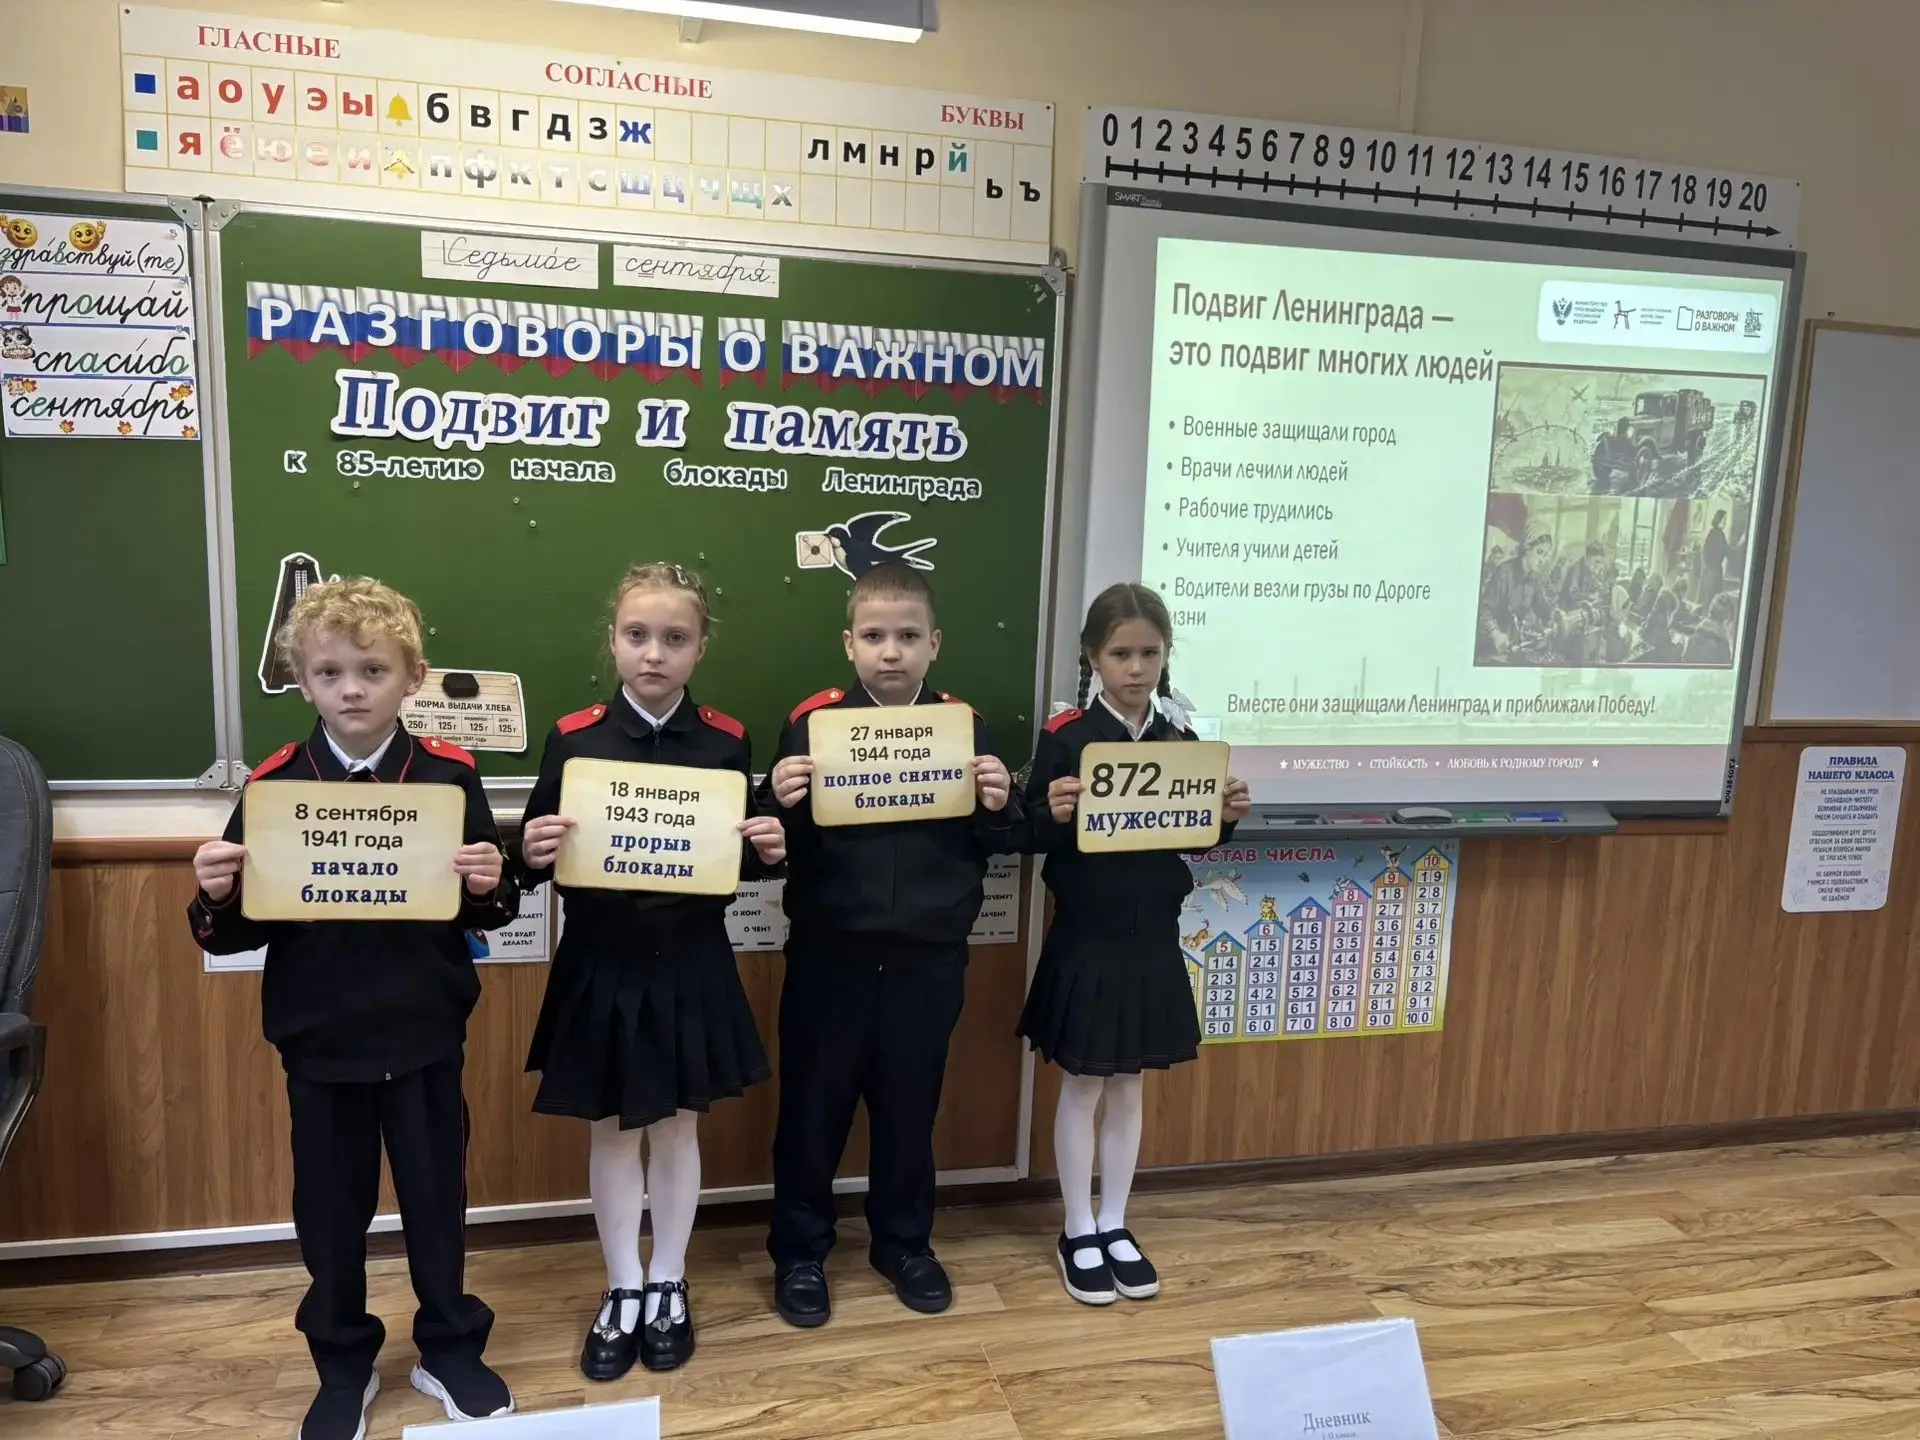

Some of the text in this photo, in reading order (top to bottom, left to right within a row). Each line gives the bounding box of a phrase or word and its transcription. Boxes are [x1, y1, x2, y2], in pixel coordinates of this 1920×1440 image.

[197, 25, 340, 60] ГЛАСНЫЕ
[545, 62, 712, 99] СОГЛАСНЫЕ
[940, 104, 1025, 130] БУКВЫ
[1103, 113, 1767, 213] 0 1 2 3 4 5 6 7 8 9 10 11 12 13 14 15 16 17 18 19 20
[1114, 191, 1142, 202] SMART
[1172, 283, 1424, 333] Подвиг Ленинграда
[1696, 309, 1739, 322] РАЗГОВОРЫ
[1695, 322, 1735, 333] О ВАЖНОМ
[261, 298, 1043, 388] РАЗГОВОРЫ О ВАЖНОМ
[1169, 340, 1493, 384] это подвиг многих людей
[338, 376, 963, 456] Подвиг и память
[1183, 415, 1396, 446] Военные защищали город
[286, 452, 980, 499] к 85-летию начала блокады Ленинграда
[1181, 457, 1348, 483] Врачи лечили людей
[1178, 497, 1333, 523] Рабочие трудились
[1175, 537, 1338, 562] Учителя учили детей
[1174, 577, 1431, 603] Водители везли грузы по Дороге
[415, 700, 512, 712] НОРМА ВЫДАЧИ ХЛЕБА
[1227, 694, 1656, 717] Вместе они защищали Ленинград и приближали Победу!
[408, 721, 423, 729] 250
[438, 722, 452, 730] 125
[470, 723, 483, 731] 125
[499, 725, 512, 733] 125
[851, 726, 933, 742] 27 января
[850, 746, 931, 762] 1944 года
[1292, 758, 1583, 770] МУЖЕСТВО СТОЙКОСТЬ ЛЮБОВЬ К РОДНОМУ ГОРОДУ
[1829, 757, 1878, 766] ПРАВИЛА
[824, 768, 963, 788] полное снятие
[1090, 762, 1216, 799] 872 дня
[1808, 771, 1895, 780] НАШЕГО КЛАССА
[610, 781, 700, 805] 18 января
[855, 792, 935, 809] блокады
[295, 804, 417, 825] 8 сентября
[605, 805, 695, 828] 1943 года
[1085, 808, 1212, 837] мужества
[301, 831, 403, 850] 1941 года
[610, 834, 691, 853] прорыв
[1266, 848, 1336, 863] ЧИСЛА
[1425, 854, 1439, 867] 10
[311, 861, 399, 876] начало
[603, 856, 694, 878] блокады
[1388, 873, 1396, 883] 9
[301, 884, 407, 905] блокады
[1305, 907, 1313, 918] 7
[1262, 924, 1270, 935] 6
[1220, 941, 1228, 953] 5
[1303, 1411, 1372, 1433] Дневник
